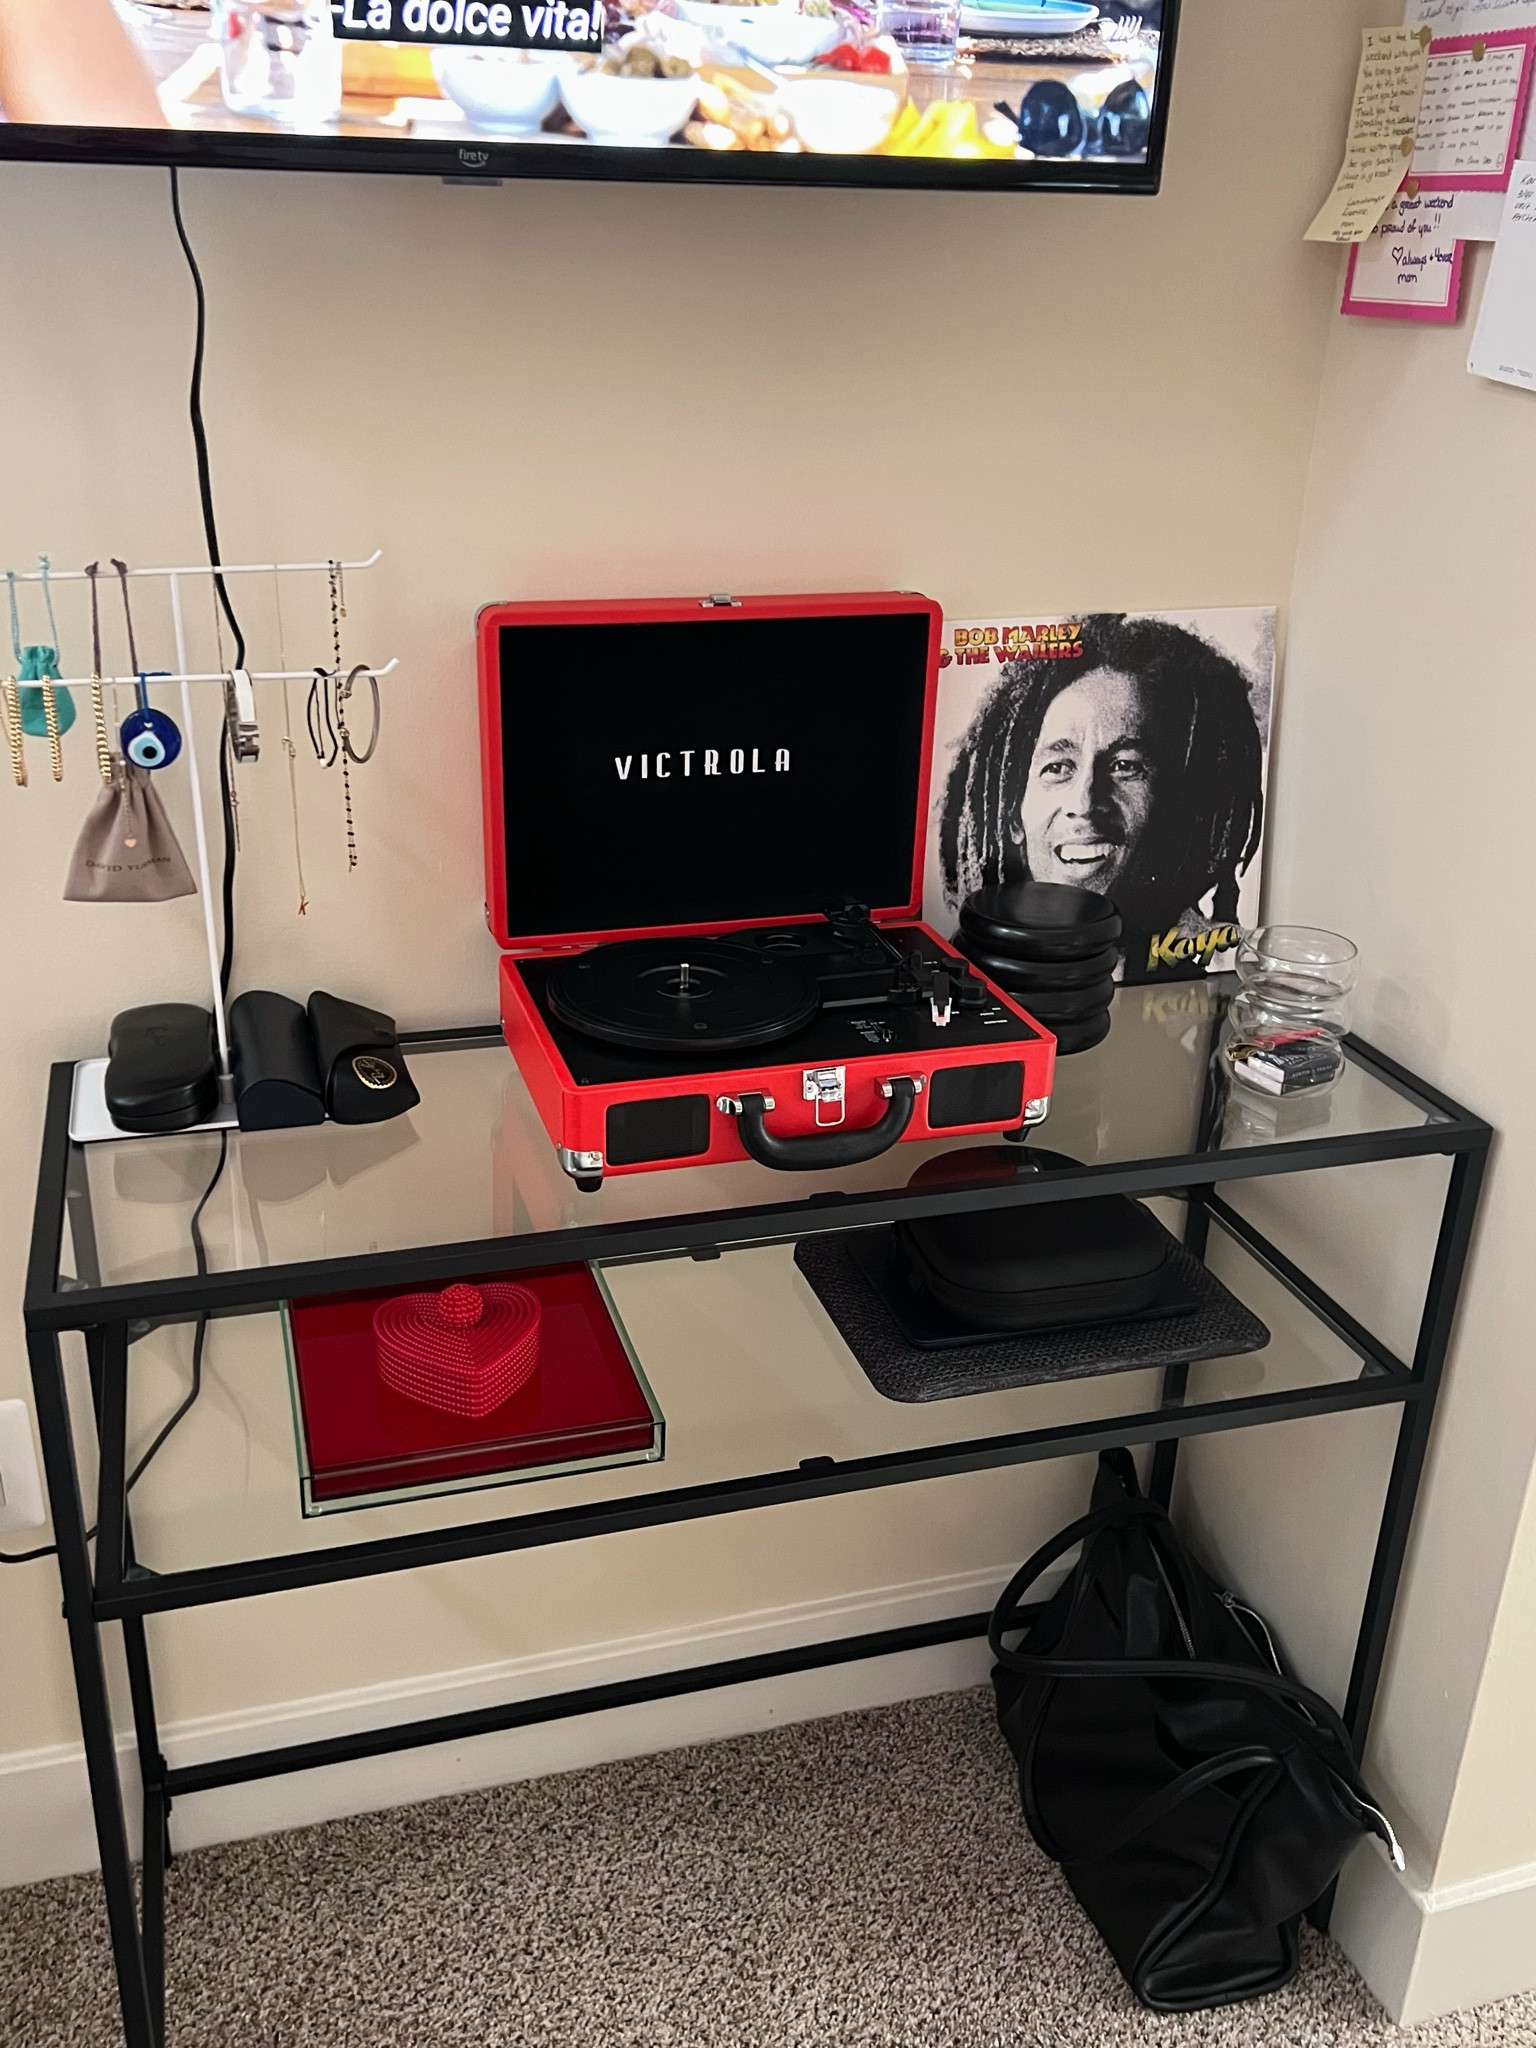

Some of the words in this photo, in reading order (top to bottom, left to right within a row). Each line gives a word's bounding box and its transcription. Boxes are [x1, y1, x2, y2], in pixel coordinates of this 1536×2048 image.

[402, 0, 512, 36] dolce
[521, 0, 601, 41] vita!
[1391, 200, 1399, 209] a
[1424, 193, 1455, 209] weekend
[1381, 220, 1405, 238] proud
[1407, 218, 1416, 233] of
[1402, 249, 1428, 272] always
[954, 627, 999, 647] BOB
[1002, 623, 1082, 645] MARLEY
[955, 646, 990, 665] THE
[993, 640, 1084, 663] WAILERS
[614, 748, 790, 780] VICTROLA
[1145, 924, 1241, 973] Kaya
